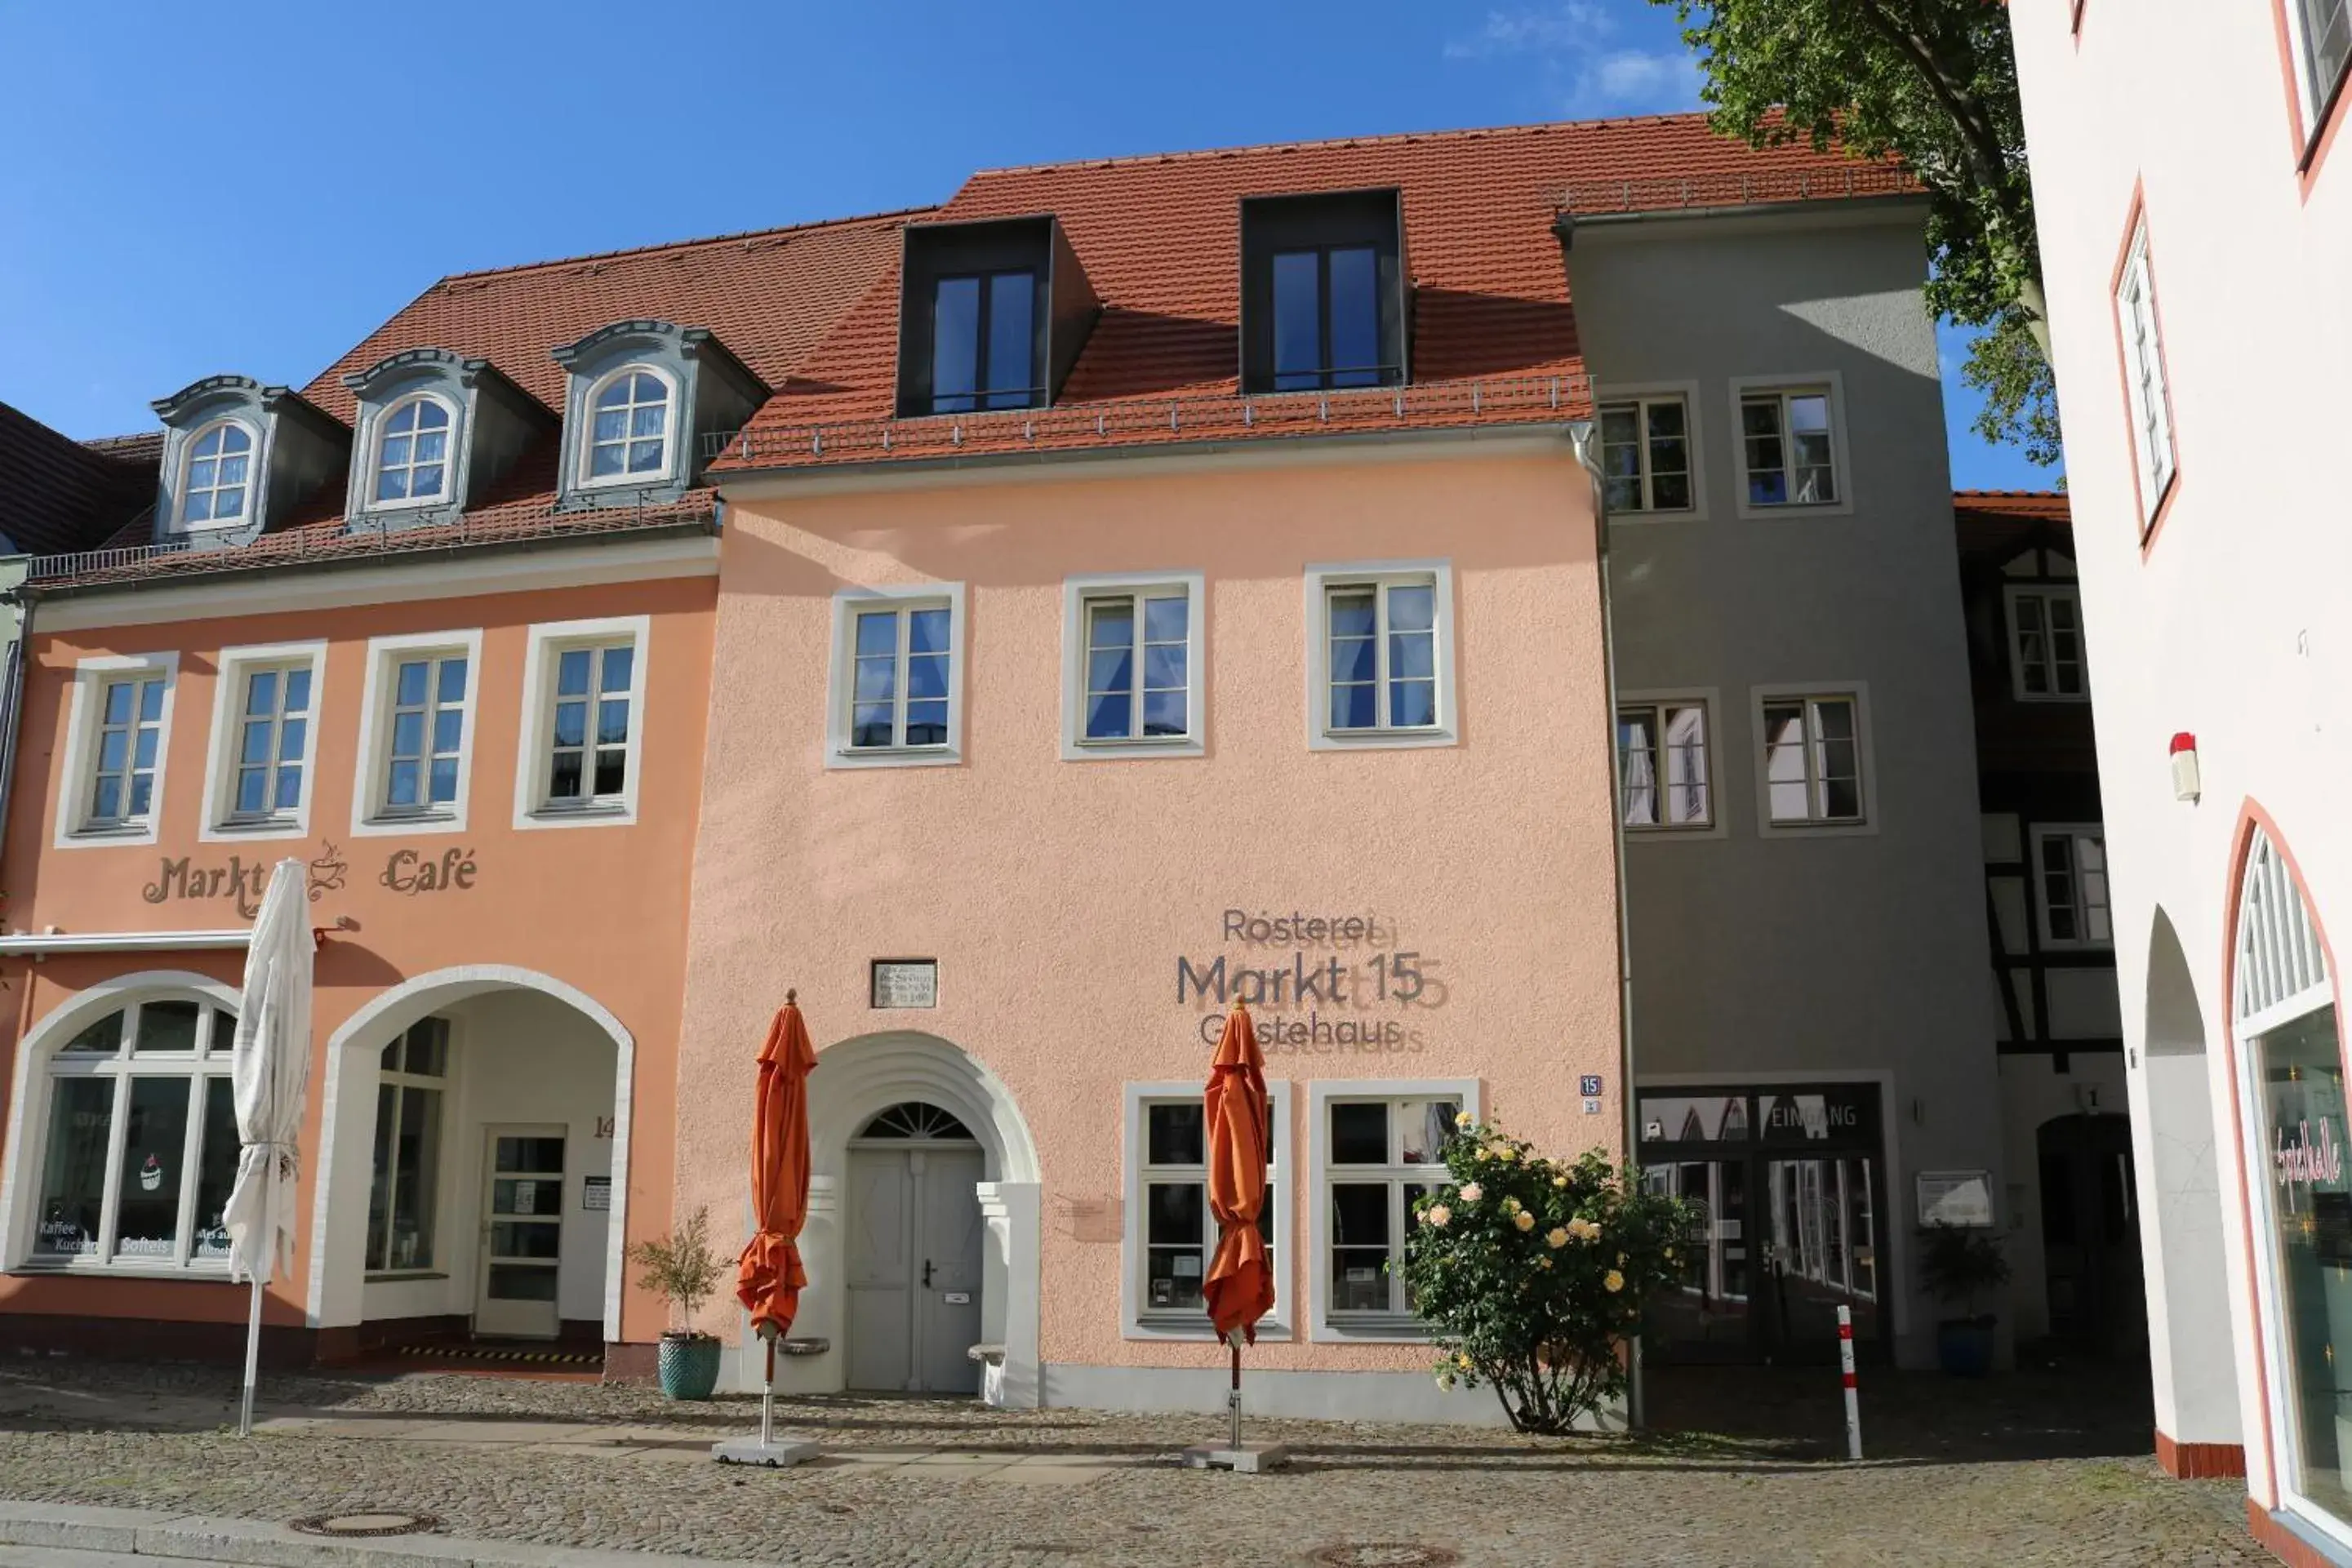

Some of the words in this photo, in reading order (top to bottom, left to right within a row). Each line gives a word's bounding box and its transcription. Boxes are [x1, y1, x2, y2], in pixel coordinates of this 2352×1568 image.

[143, 855, 265, 921] Markt
[379, 847, 478, 896] Café
[1177, 952, 1347, 1004] Markt
[1367, 952, 1425, 1002] 15
[1200, 1011, 1401, 1046] Gstehaus
[1583, 1077, 1598, 1093] 15
[594, 1115, 615, 1139] 14
[1772, 1104, 1856, 1127] EINGANG
[40, 1220, 77, 1235] Kaffee
[55, 1237, 99, 1254] Kuchen
[121, 1237, 169, 1254] Softeis
